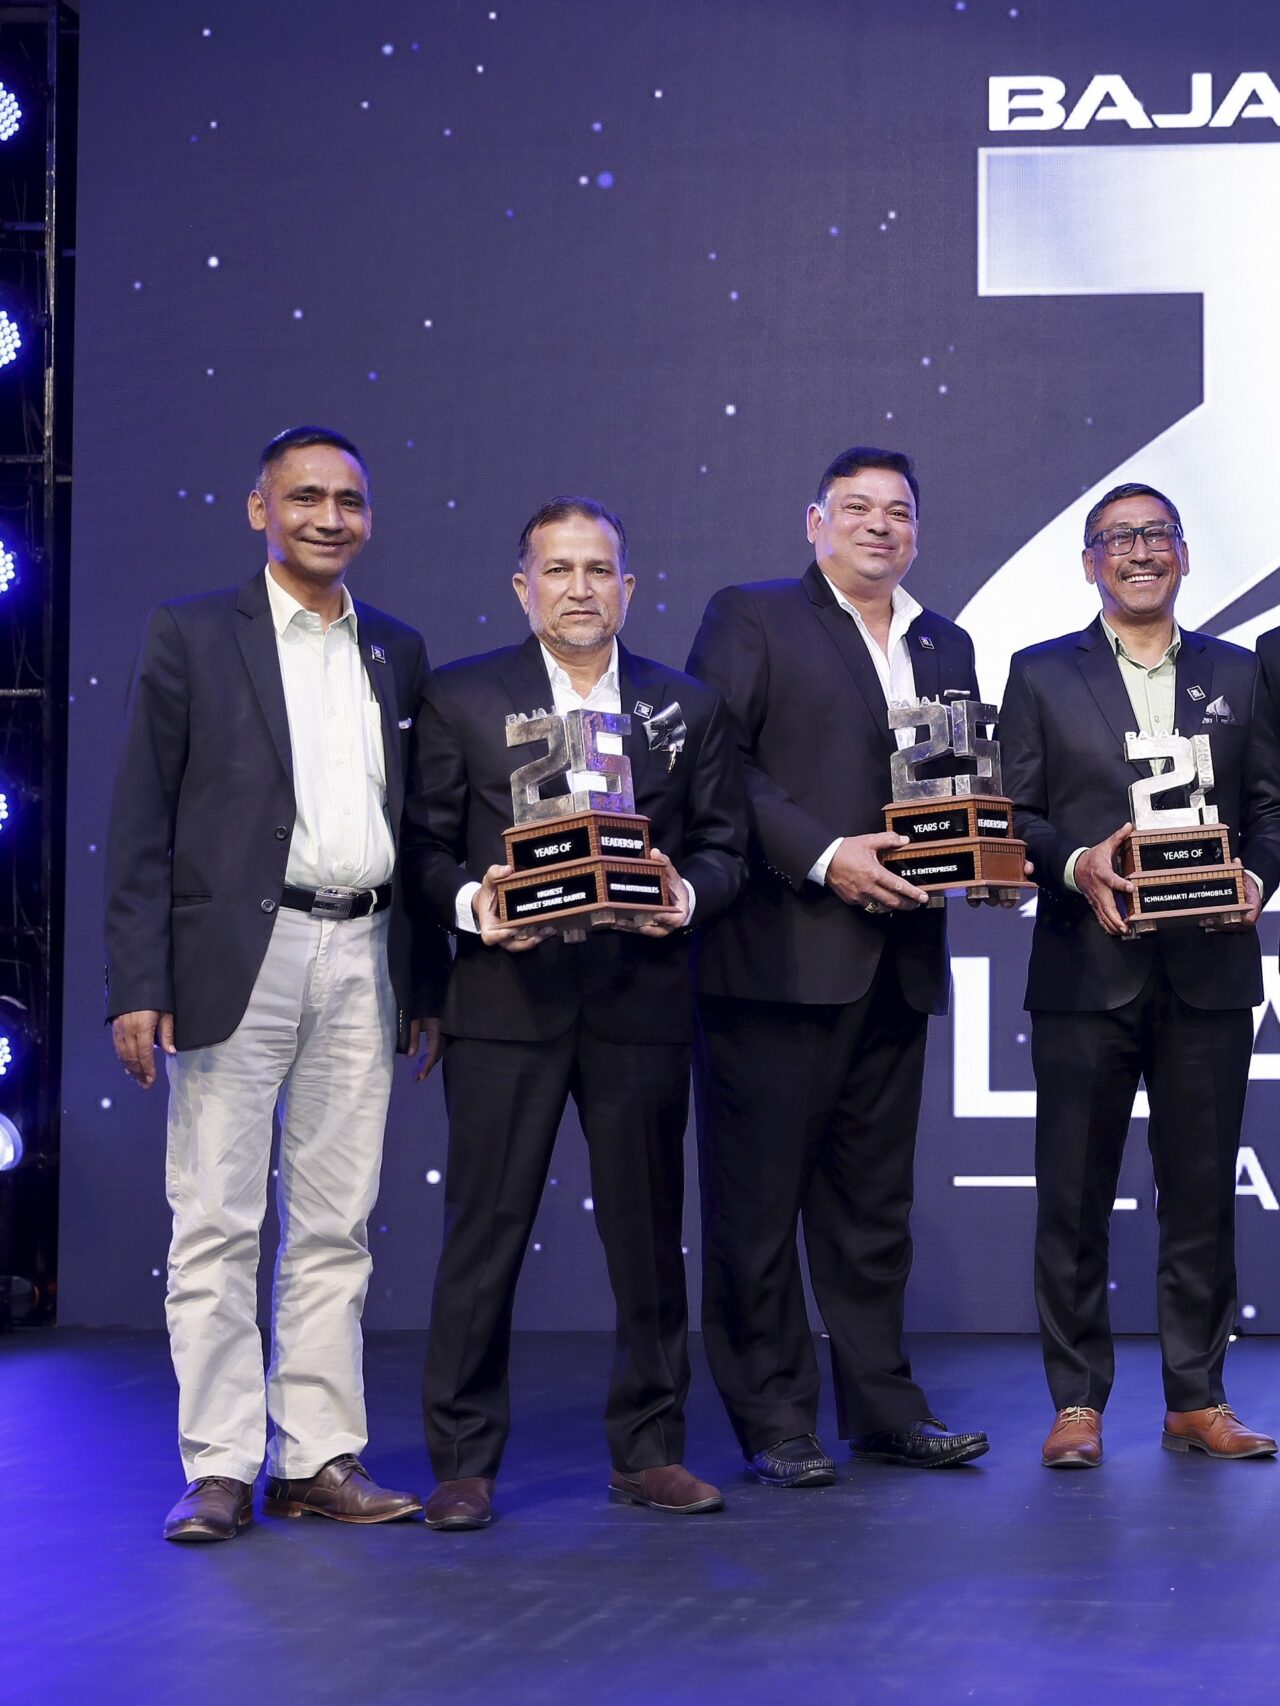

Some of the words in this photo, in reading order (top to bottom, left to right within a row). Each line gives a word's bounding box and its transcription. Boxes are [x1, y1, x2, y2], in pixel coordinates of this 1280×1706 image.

[1125, 728, 1180, 740] BAAJ
[887, 699, 1003, 801] 25
[505, 708, 635, 827] 25
[913, 822, 938, 833] YEARS
[938, 820, 951, 831] OF
[977, 818, 1009, 830] LEADERSHIP
[534, 844, 559, 858] YEARS
[559, 841, 572, 853] OF
[601, 836, 643, 850] LEADERSHIP
[1163, 850, 1190, 860] YEARS
[1190, 848, 1203, 858] OF
[917, 864, 958, 875] ENTERPRISES
[537, 886, 564, 899] HIGHEST
[1144, 892, 1188, 903] ICHHASHAKTI
[1188, 888, 1233, 899] AUTOMOBILES
[516, 900, 542, 913] MARKET
[542, 896, 563, 908] SHARE
